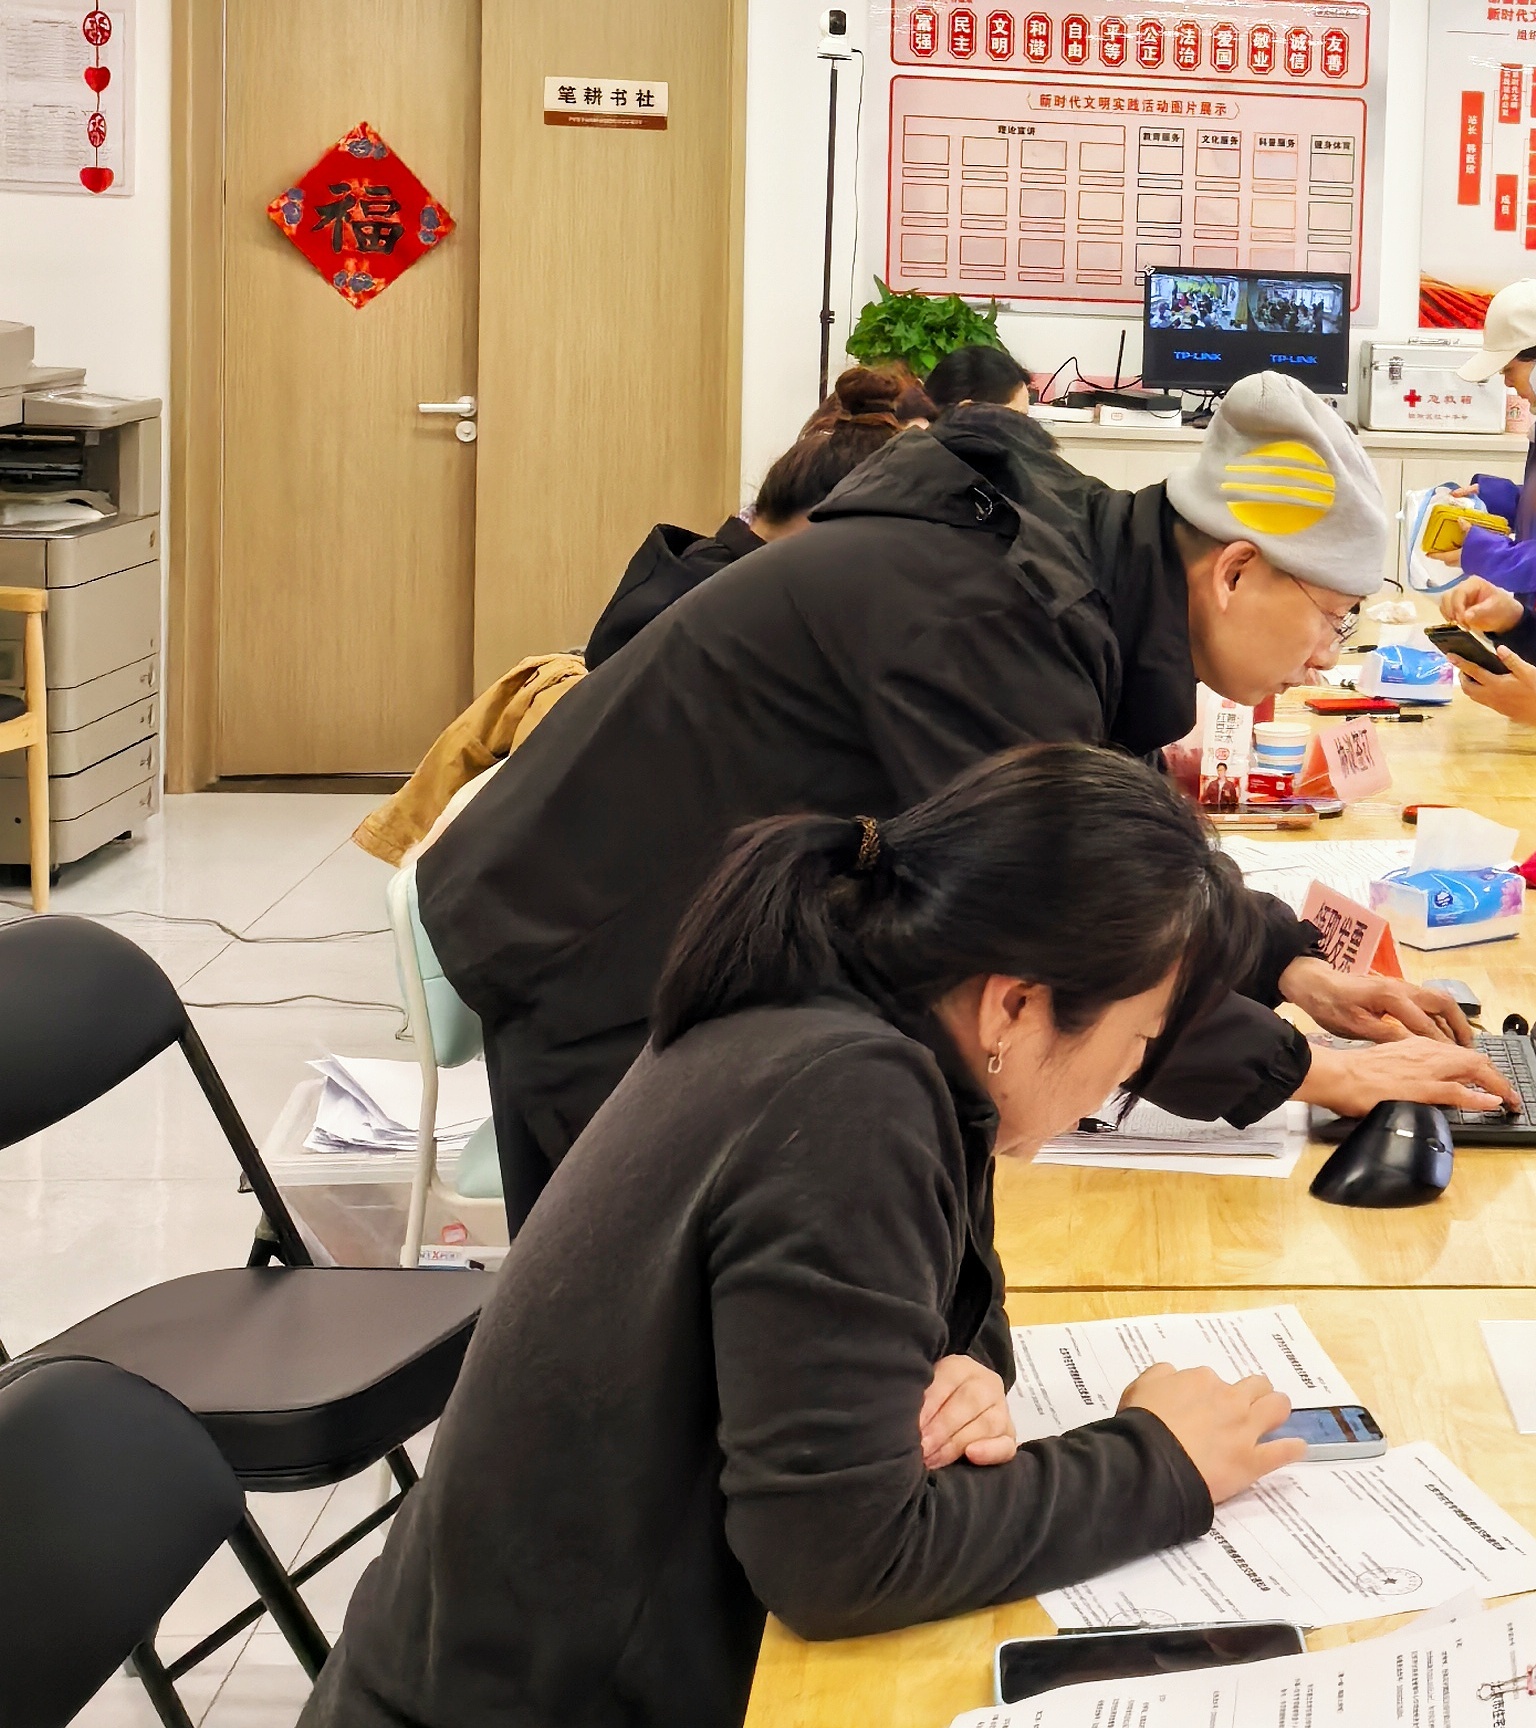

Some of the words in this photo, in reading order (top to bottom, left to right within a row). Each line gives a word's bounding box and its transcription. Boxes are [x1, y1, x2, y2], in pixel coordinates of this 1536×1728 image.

[953, 16, 971, 52] 民主
[991, 18, 1009, 54] 文明
[1029, 20, 1047, 57] 和谐
[1066, 22, 1083, 59] 自由
[1104, 24, 1122, 61] 平等
[1141, 27, 1159, 61] 公正
[1178, 28, 1196, 64] 法治
[1216, 30, 1234, 65] 爱国
[1252, 32, 1270, 68] 敬业
[1289, 34, 1307, 70] 诚信
[1326, 35, 1344, 71] 友善
[558, 85, 655, 108] 笔耕书社
[1039, 93, 1227, 116] 新时代文明实践活动图片展示
[311, 179, 406, 256] 福
[1173, 351, 1222, 362] TP-LINK
[1269, 354, 1318, 364] TP-LINK
[1427, 394, 1472, 405] 急救箱
